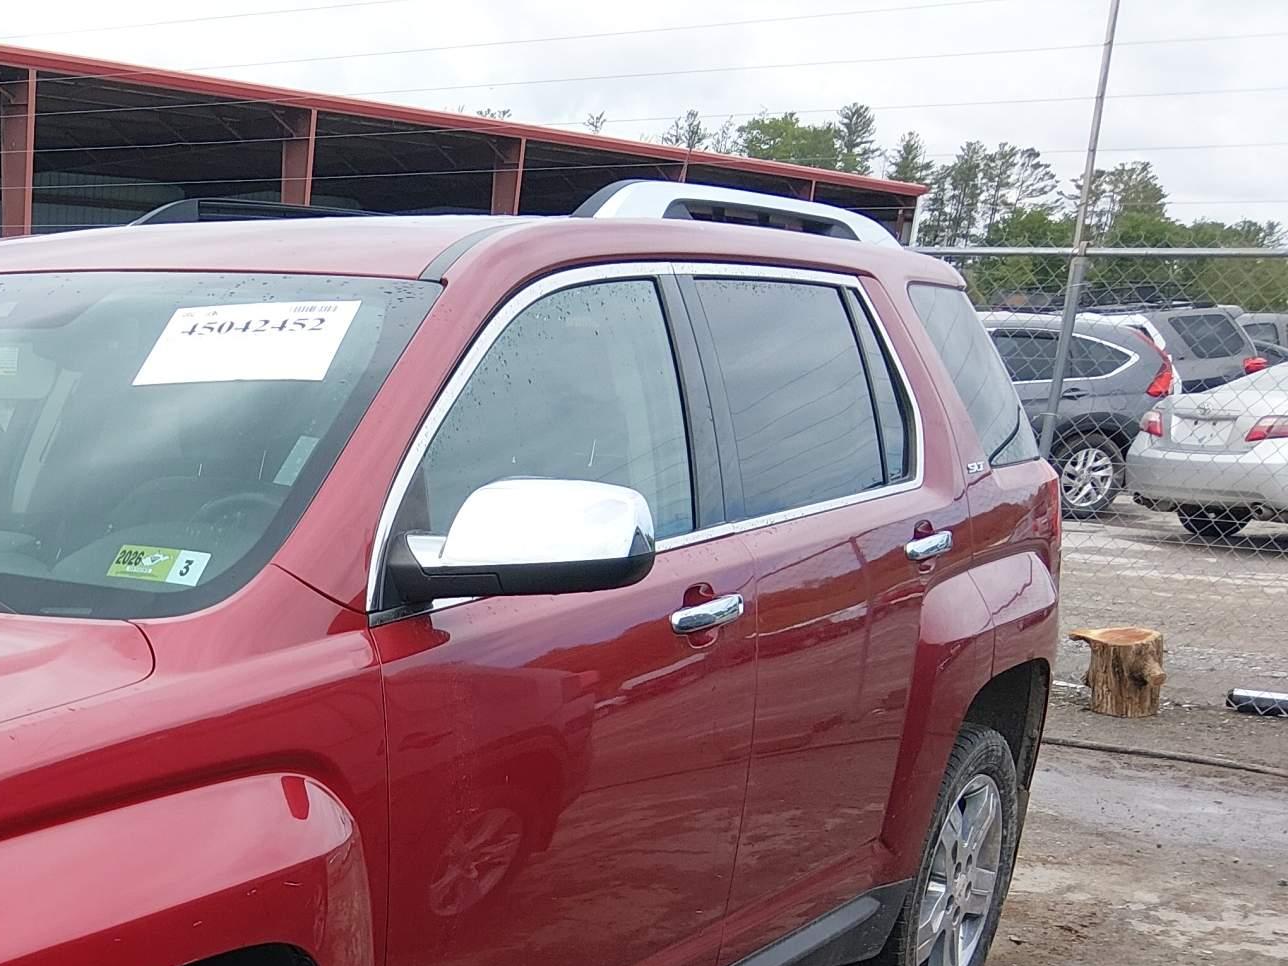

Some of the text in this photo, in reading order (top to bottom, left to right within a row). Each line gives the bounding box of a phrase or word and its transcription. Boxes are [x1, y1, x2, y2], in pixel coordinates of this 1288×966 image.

[181, 317, 326, 336] 45042452
[115, 550, 194, 577] 2026 3
